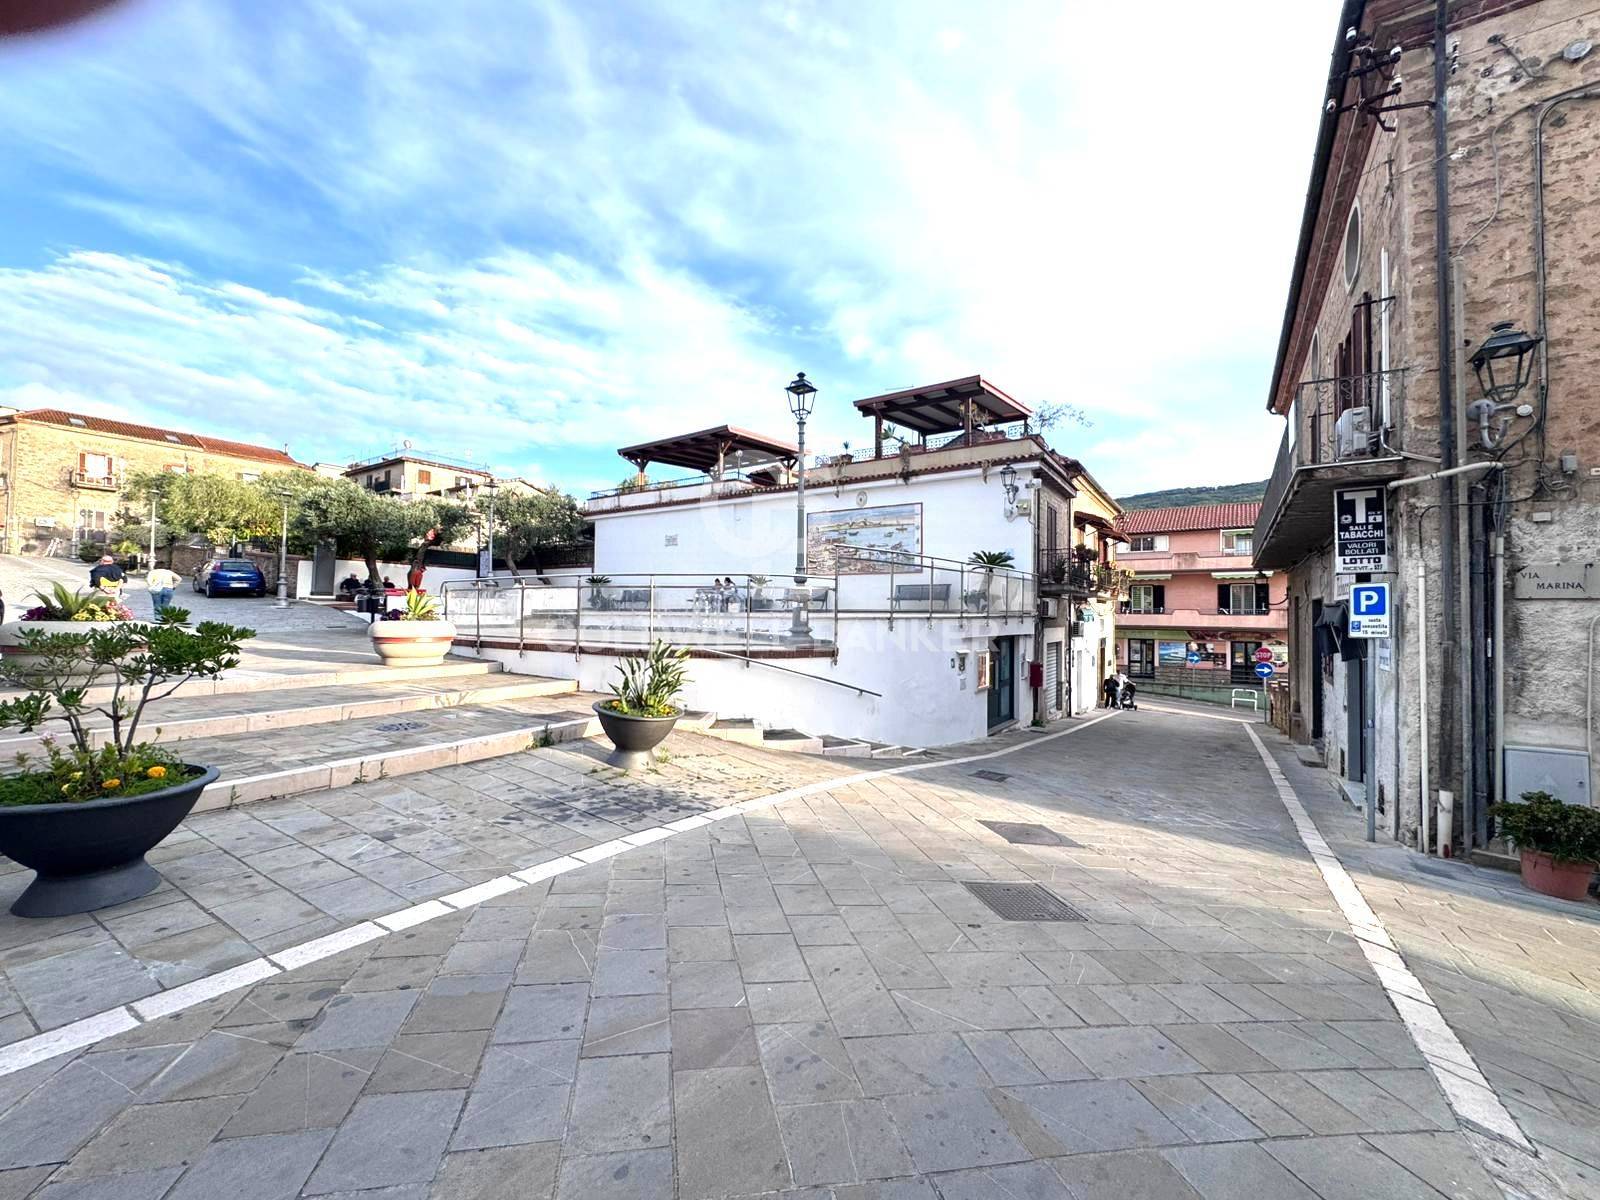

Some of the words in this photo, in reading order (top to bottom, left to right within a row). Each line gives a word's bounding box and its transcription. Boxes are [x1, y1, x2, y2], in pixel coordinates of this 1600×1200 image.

[1343, 490, 1377, 524] T
[1339, 529, 1384, 540] TABACCHI
[1346, 541, 1377, 549] VALORI
[1343, 556, 1382, 565] LOTTO
[1536, 582, 1583, 590] MARINA
[1360, 590, 1379, 613] P
